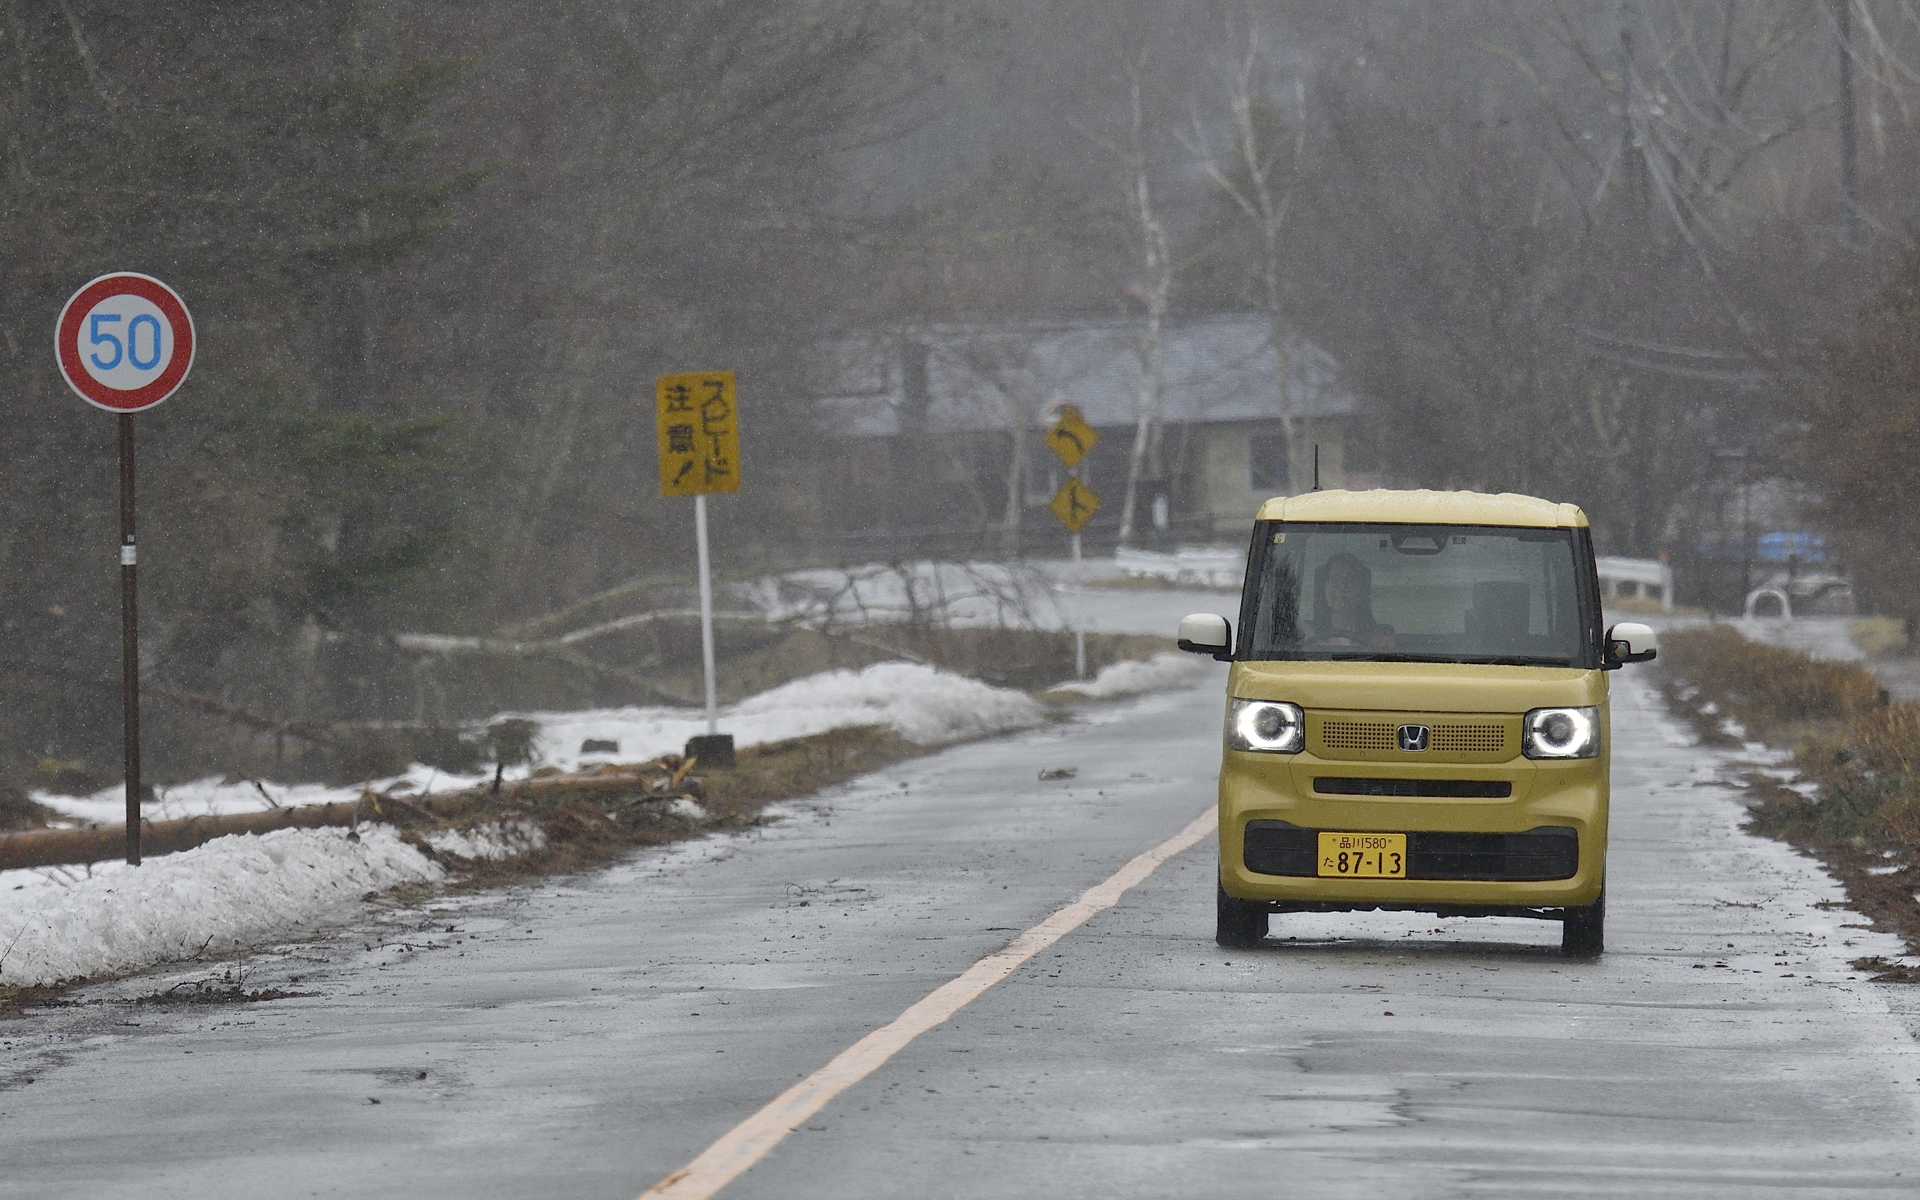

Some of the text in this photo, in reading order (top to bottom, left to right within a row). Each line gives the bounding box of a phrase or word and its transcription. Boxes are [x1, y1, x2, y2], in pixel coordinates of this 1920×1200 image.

[90, 313, 162, 371] 50
[701, 380, 731, 485] スピード
[1323, 851, 1402, 875] た 87-13
